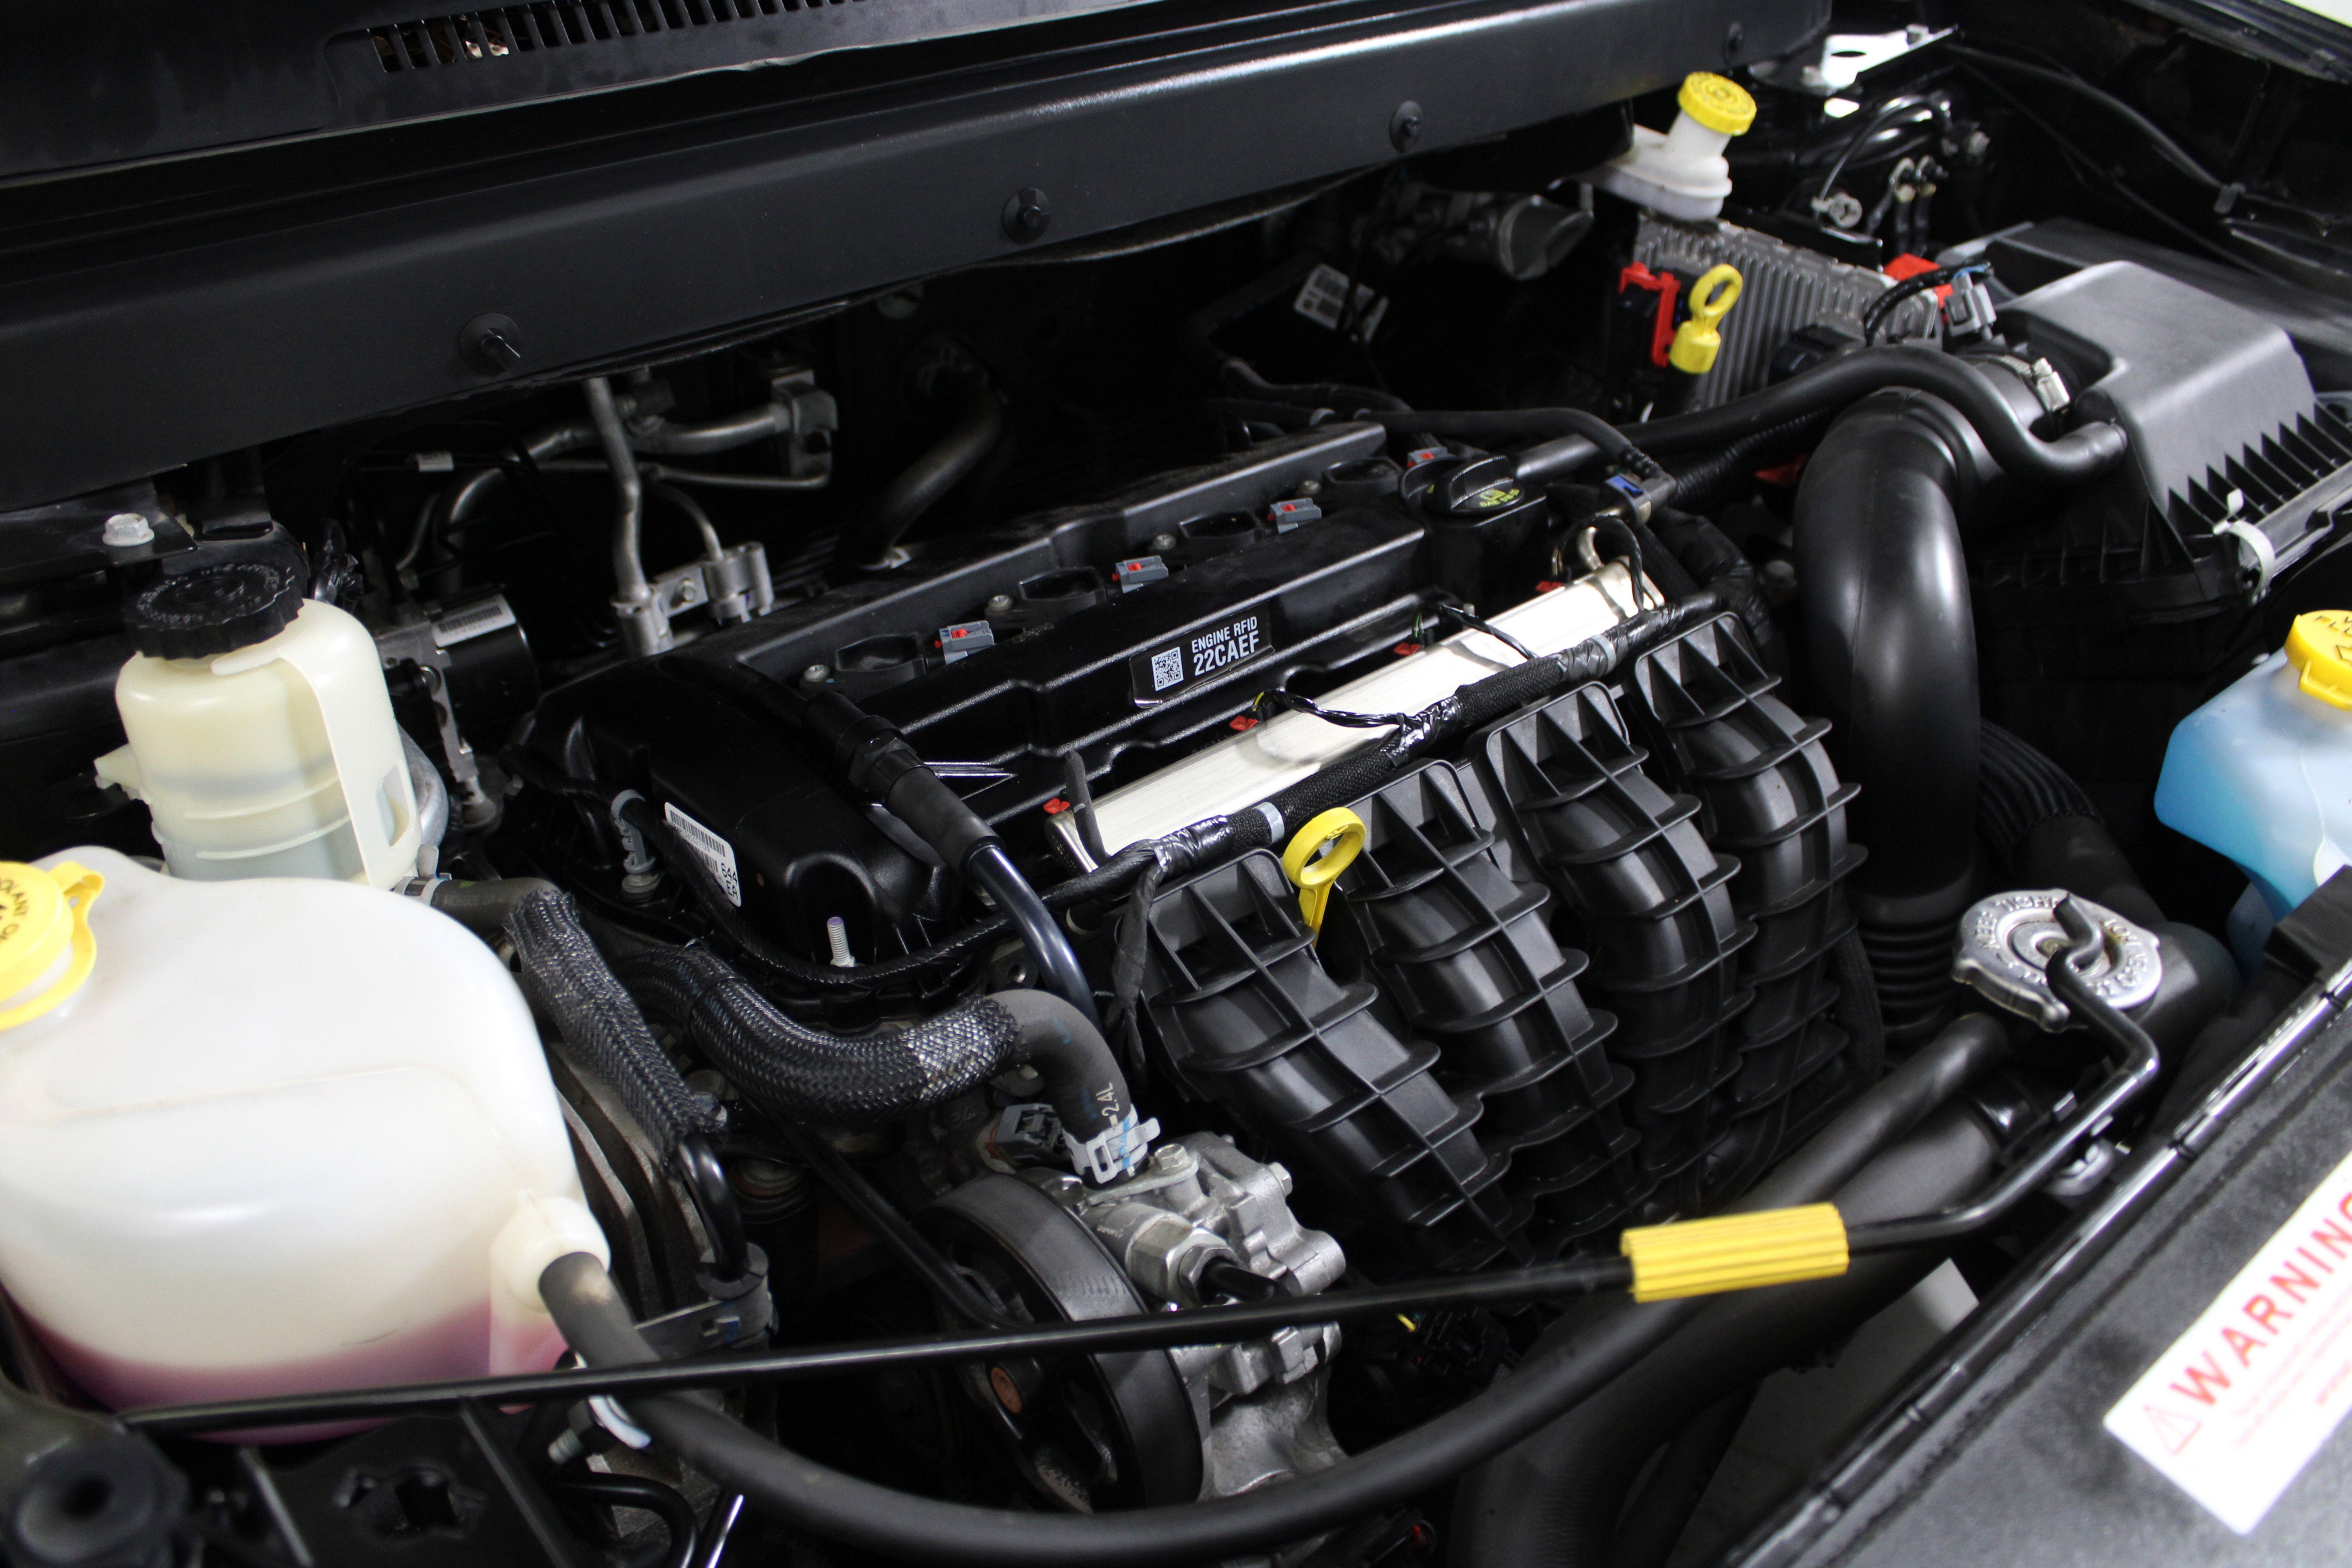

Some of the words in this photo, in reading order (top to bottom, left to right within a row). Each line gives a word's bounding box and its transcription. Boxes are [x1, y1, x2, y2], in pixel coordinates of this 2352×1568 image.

[1192, 626, 1231, 653] ENGINE
[1233, 616, 1258, 637] RFID
[1193, 630, 1259, 676] 22CAEF
[721, 862, 738, 886] 644
[726, 880, 738, 900] EA
[1095, 1082, 1120, 1116] 2.4L
